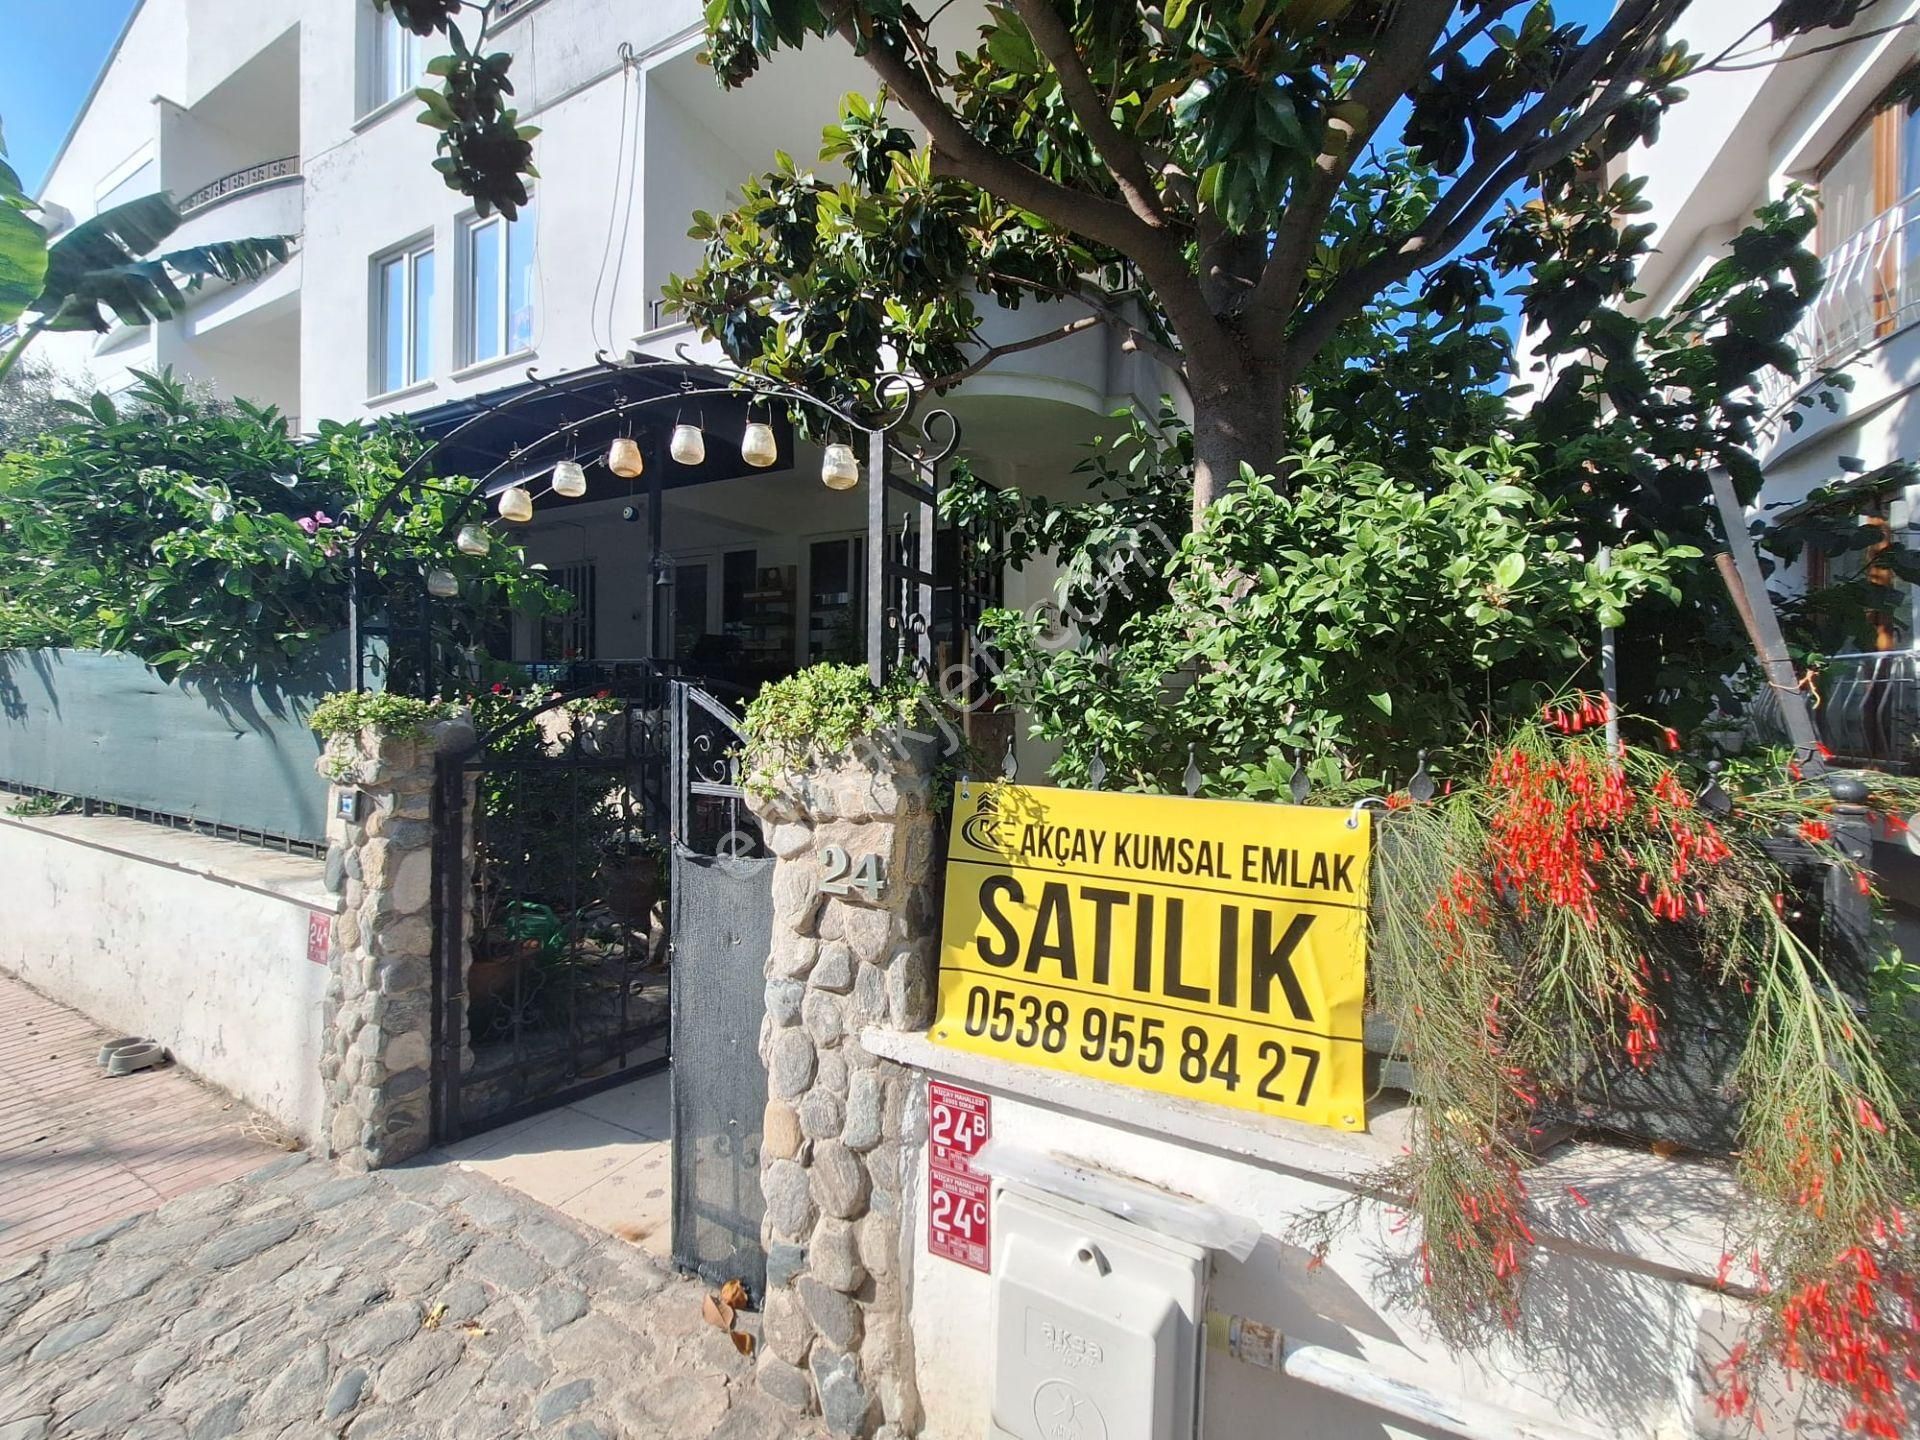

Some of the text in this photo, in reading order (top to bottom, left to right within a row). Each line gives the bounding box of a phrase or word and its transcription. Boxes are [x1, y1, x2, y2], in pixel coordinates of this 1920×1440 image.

[819, 845, 885, 899] 24
[1020, 824, 1356, 893] AKÇAY KUMSAL EMLAK
[976, 875, 1316, 1023] SATILIK
[964, 985, 1321, 1107] 0538 955 84 27
